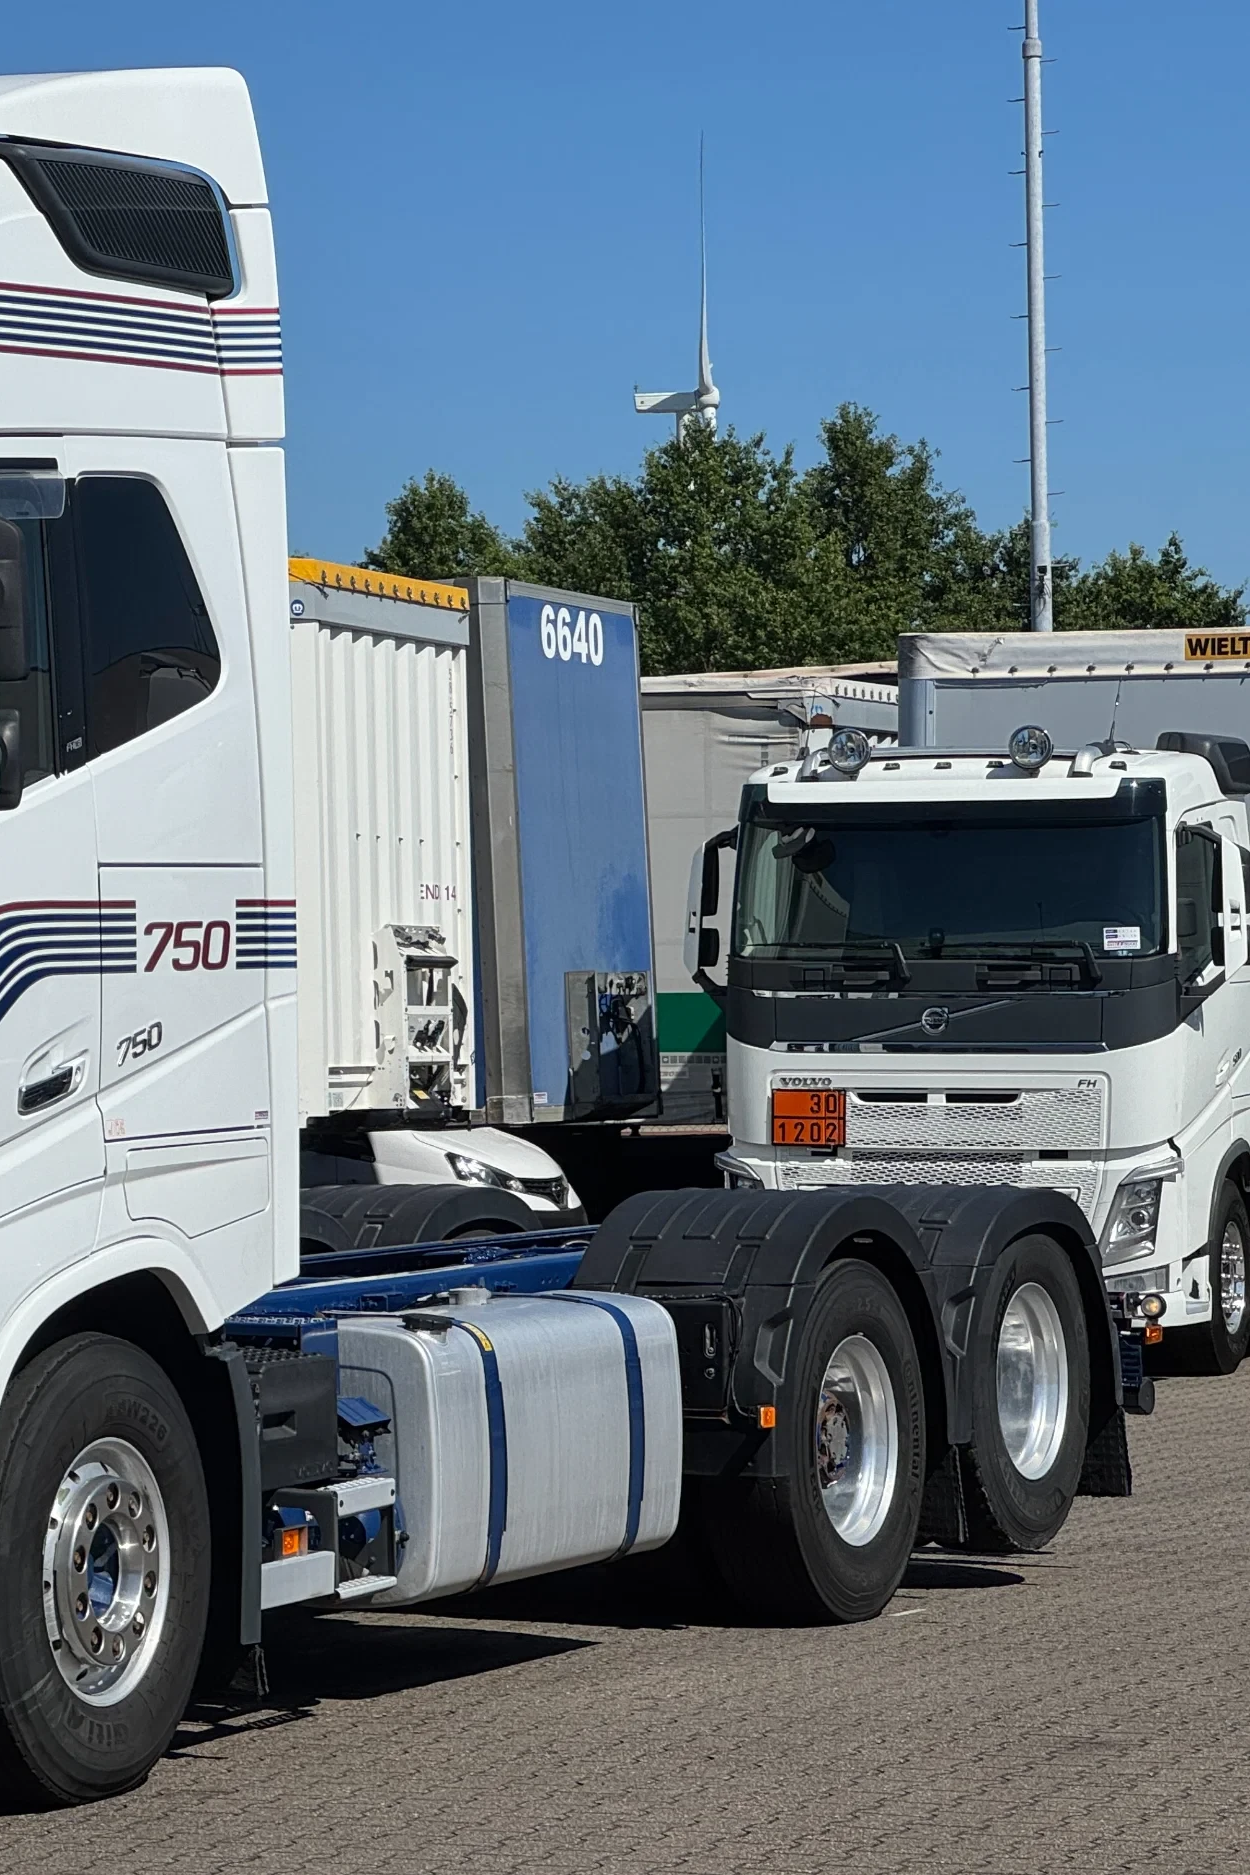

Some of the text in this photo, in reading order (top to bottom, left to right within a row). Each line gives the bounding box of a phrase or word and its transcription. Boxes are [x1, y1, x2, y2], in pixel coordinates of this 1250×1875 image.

[541, 604, 604, 667] 6640
[1187, 636, 1250, 657] WIELT
[143, 920, 231, 973] 750
[116, 1021, 163, 1067] 750
[779, 1077, 832, 1087] VOLVO
[1077, 1079, 1098, 1088] FH
[810, 1094, 837, 1114] 30
[778, 1121, 837, 1143] 1202
